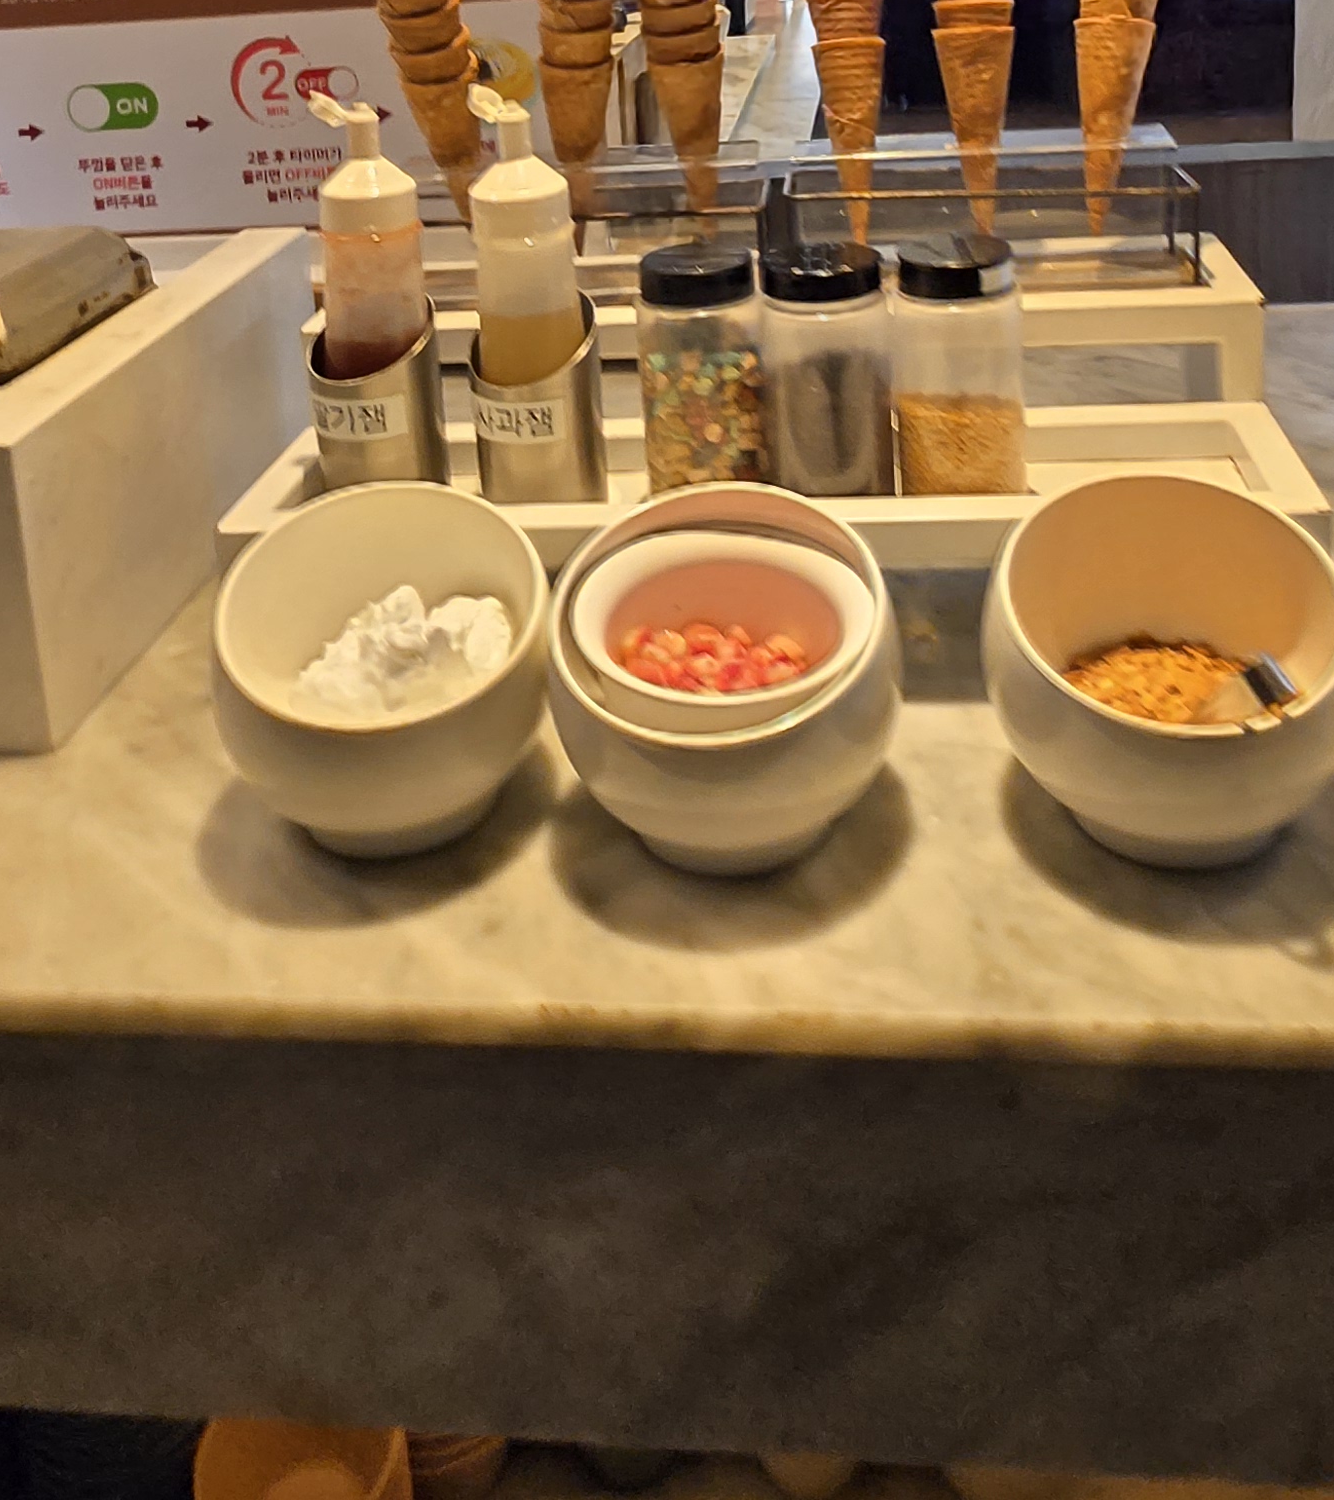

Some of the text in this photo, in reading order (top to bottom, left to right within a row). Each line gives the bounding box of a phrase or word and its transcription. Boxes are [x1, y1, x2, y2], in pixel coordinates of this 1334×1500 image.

[259, 60, 289, 101] 2
[297, 77, 327, 92] OFF
[116, 98, 148, 114] ON
[78, 157, 116, 173] 뚜껑을
[151, 154, 163, 171] 후
[248, 146, 342, 165] 2분 후 타이머가
[93, 174, 153, 192] ON버튼을
[243, 166, 336, 184] 울리면 OFF버
[94, 194, 158, 212] 눌러주세요
[267, 185, 319, 203] 눌러주세
[478, 402, 554, 438] 사과잼
